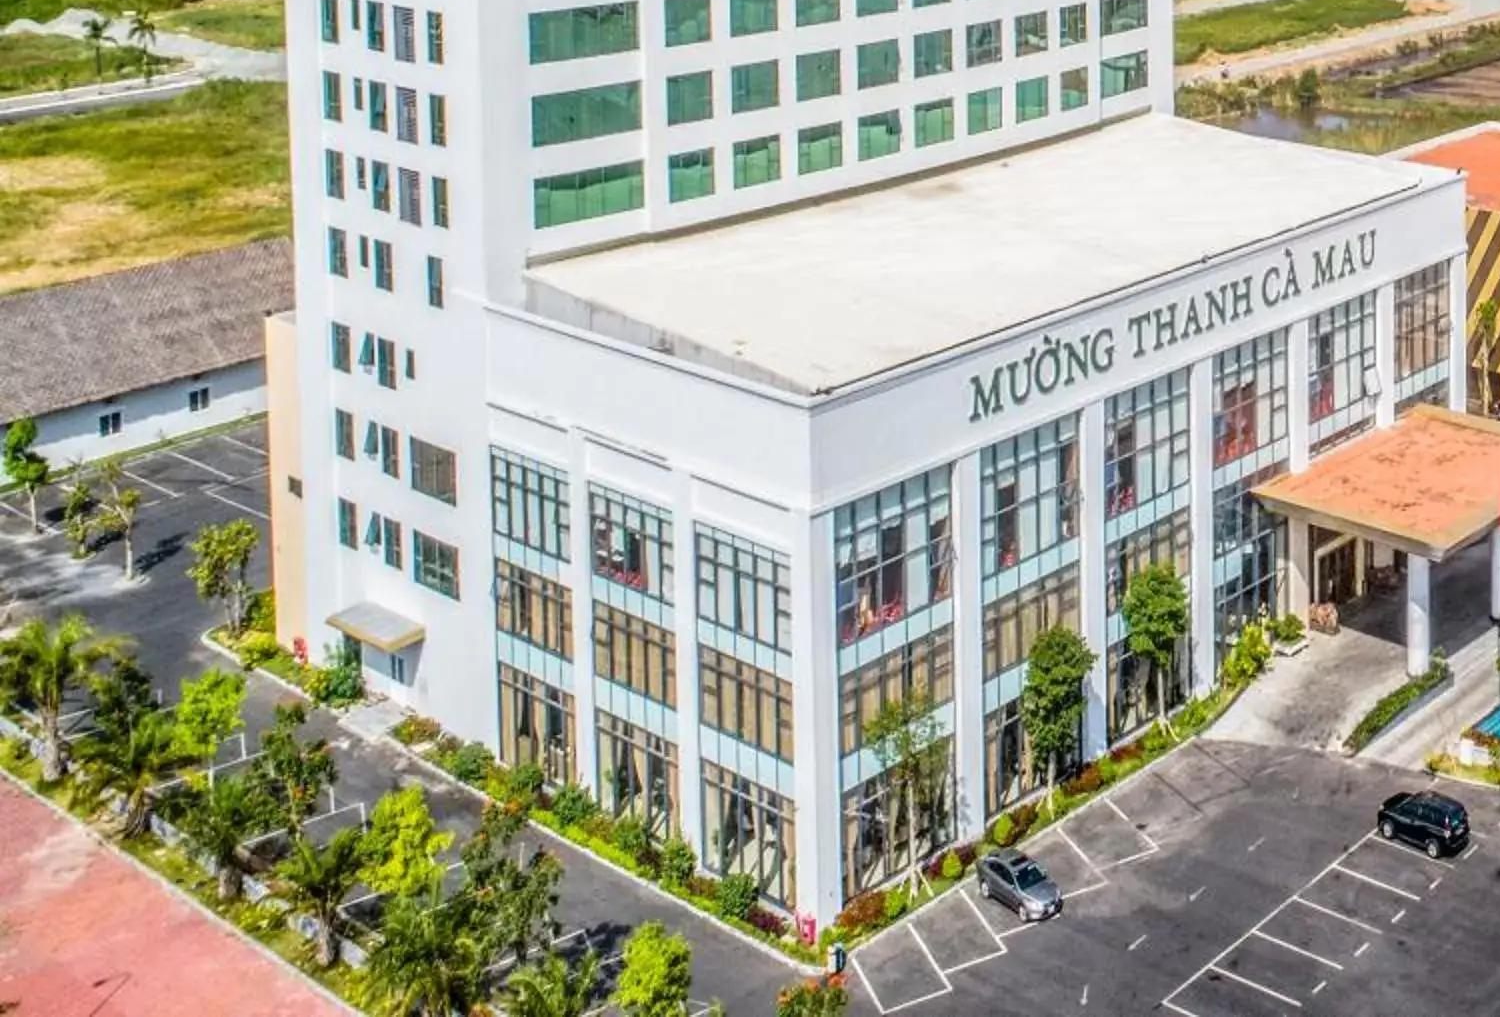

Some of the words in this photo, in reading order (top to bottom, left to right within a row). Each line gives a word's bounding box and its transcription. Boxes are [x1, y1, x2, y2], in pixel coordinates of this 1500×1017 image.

[969, 333, 1115, 422] MƯỜNG
[1127, 275, 1253, 358] THANH
[1260, 246, 1302, 307] CÀ
[1311, 229, 1377, 289] MAU
